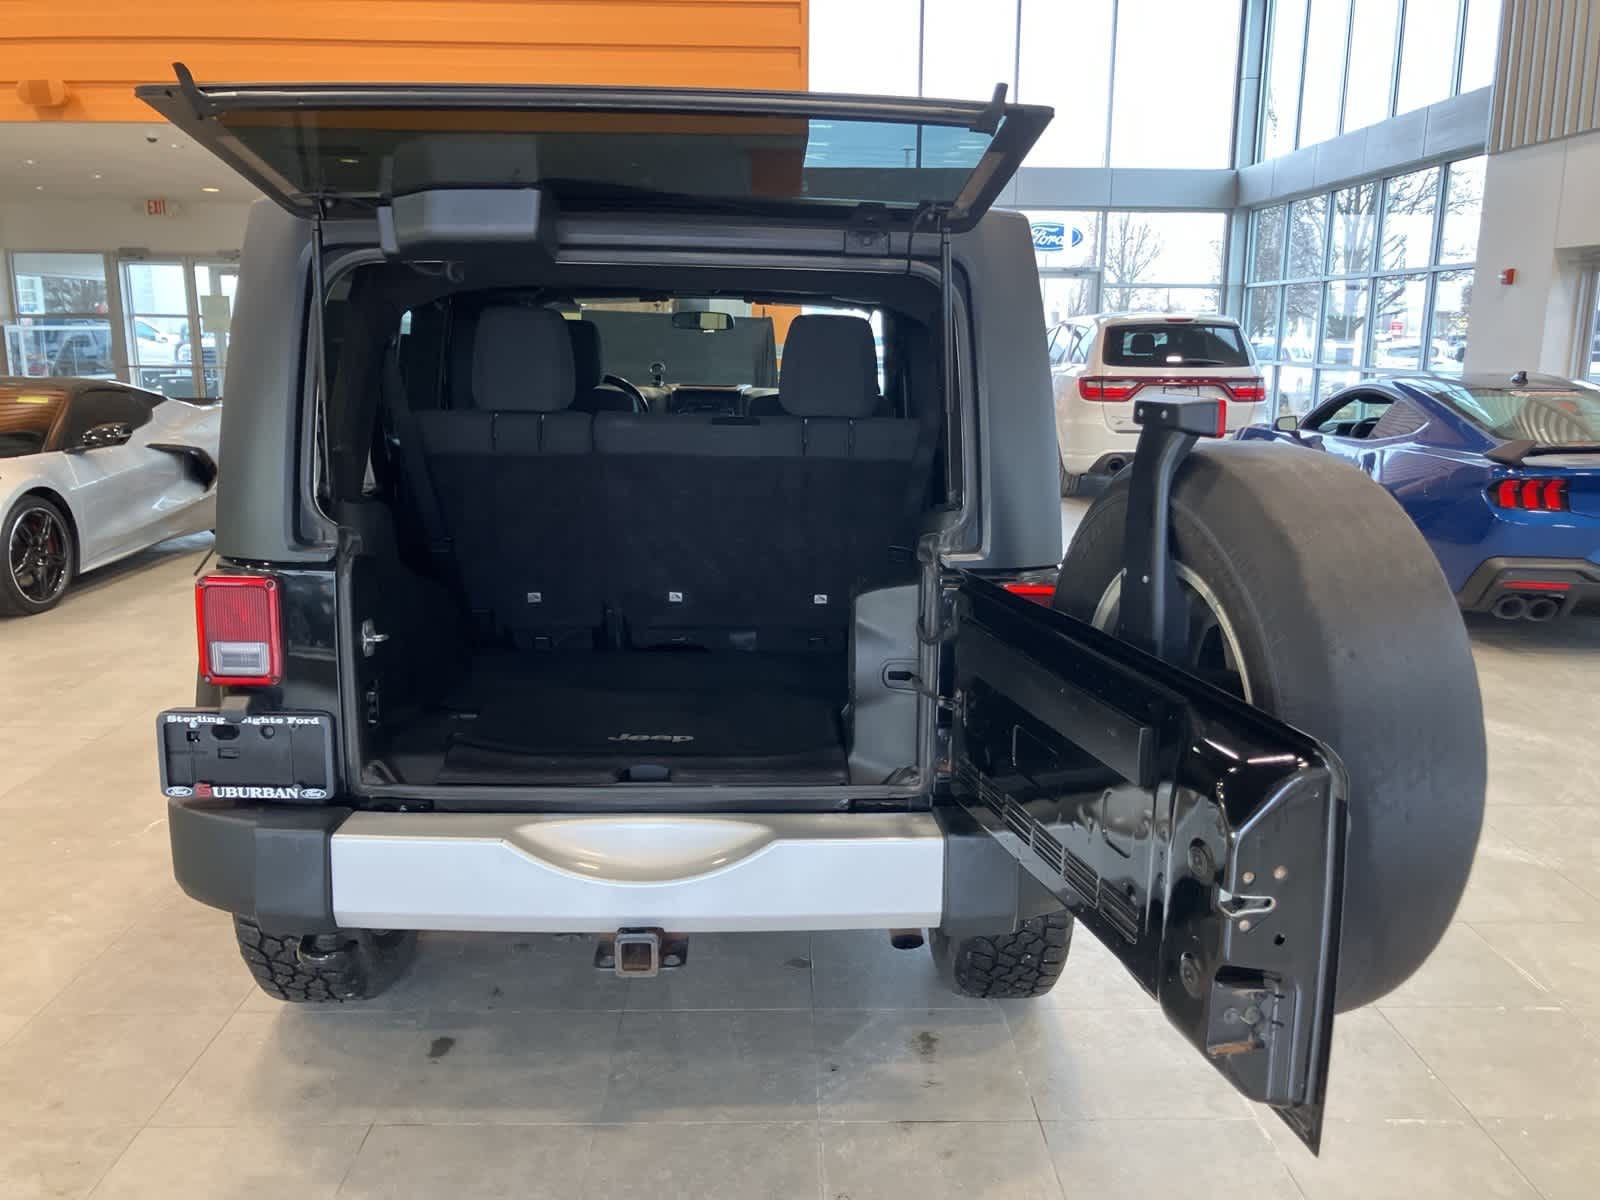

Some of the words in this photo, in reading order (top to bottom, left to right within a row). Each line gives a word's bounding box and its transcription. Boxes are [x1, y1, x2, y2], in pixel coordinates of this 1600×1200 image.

[167, 715, 225, 725] Sterling
[241, 716, 283, 725] ights
[286, 717, 319, 725] Ford
[607, 733, 695, 743] Jeep
[195, 783, 299, 799] SUBURBAN
